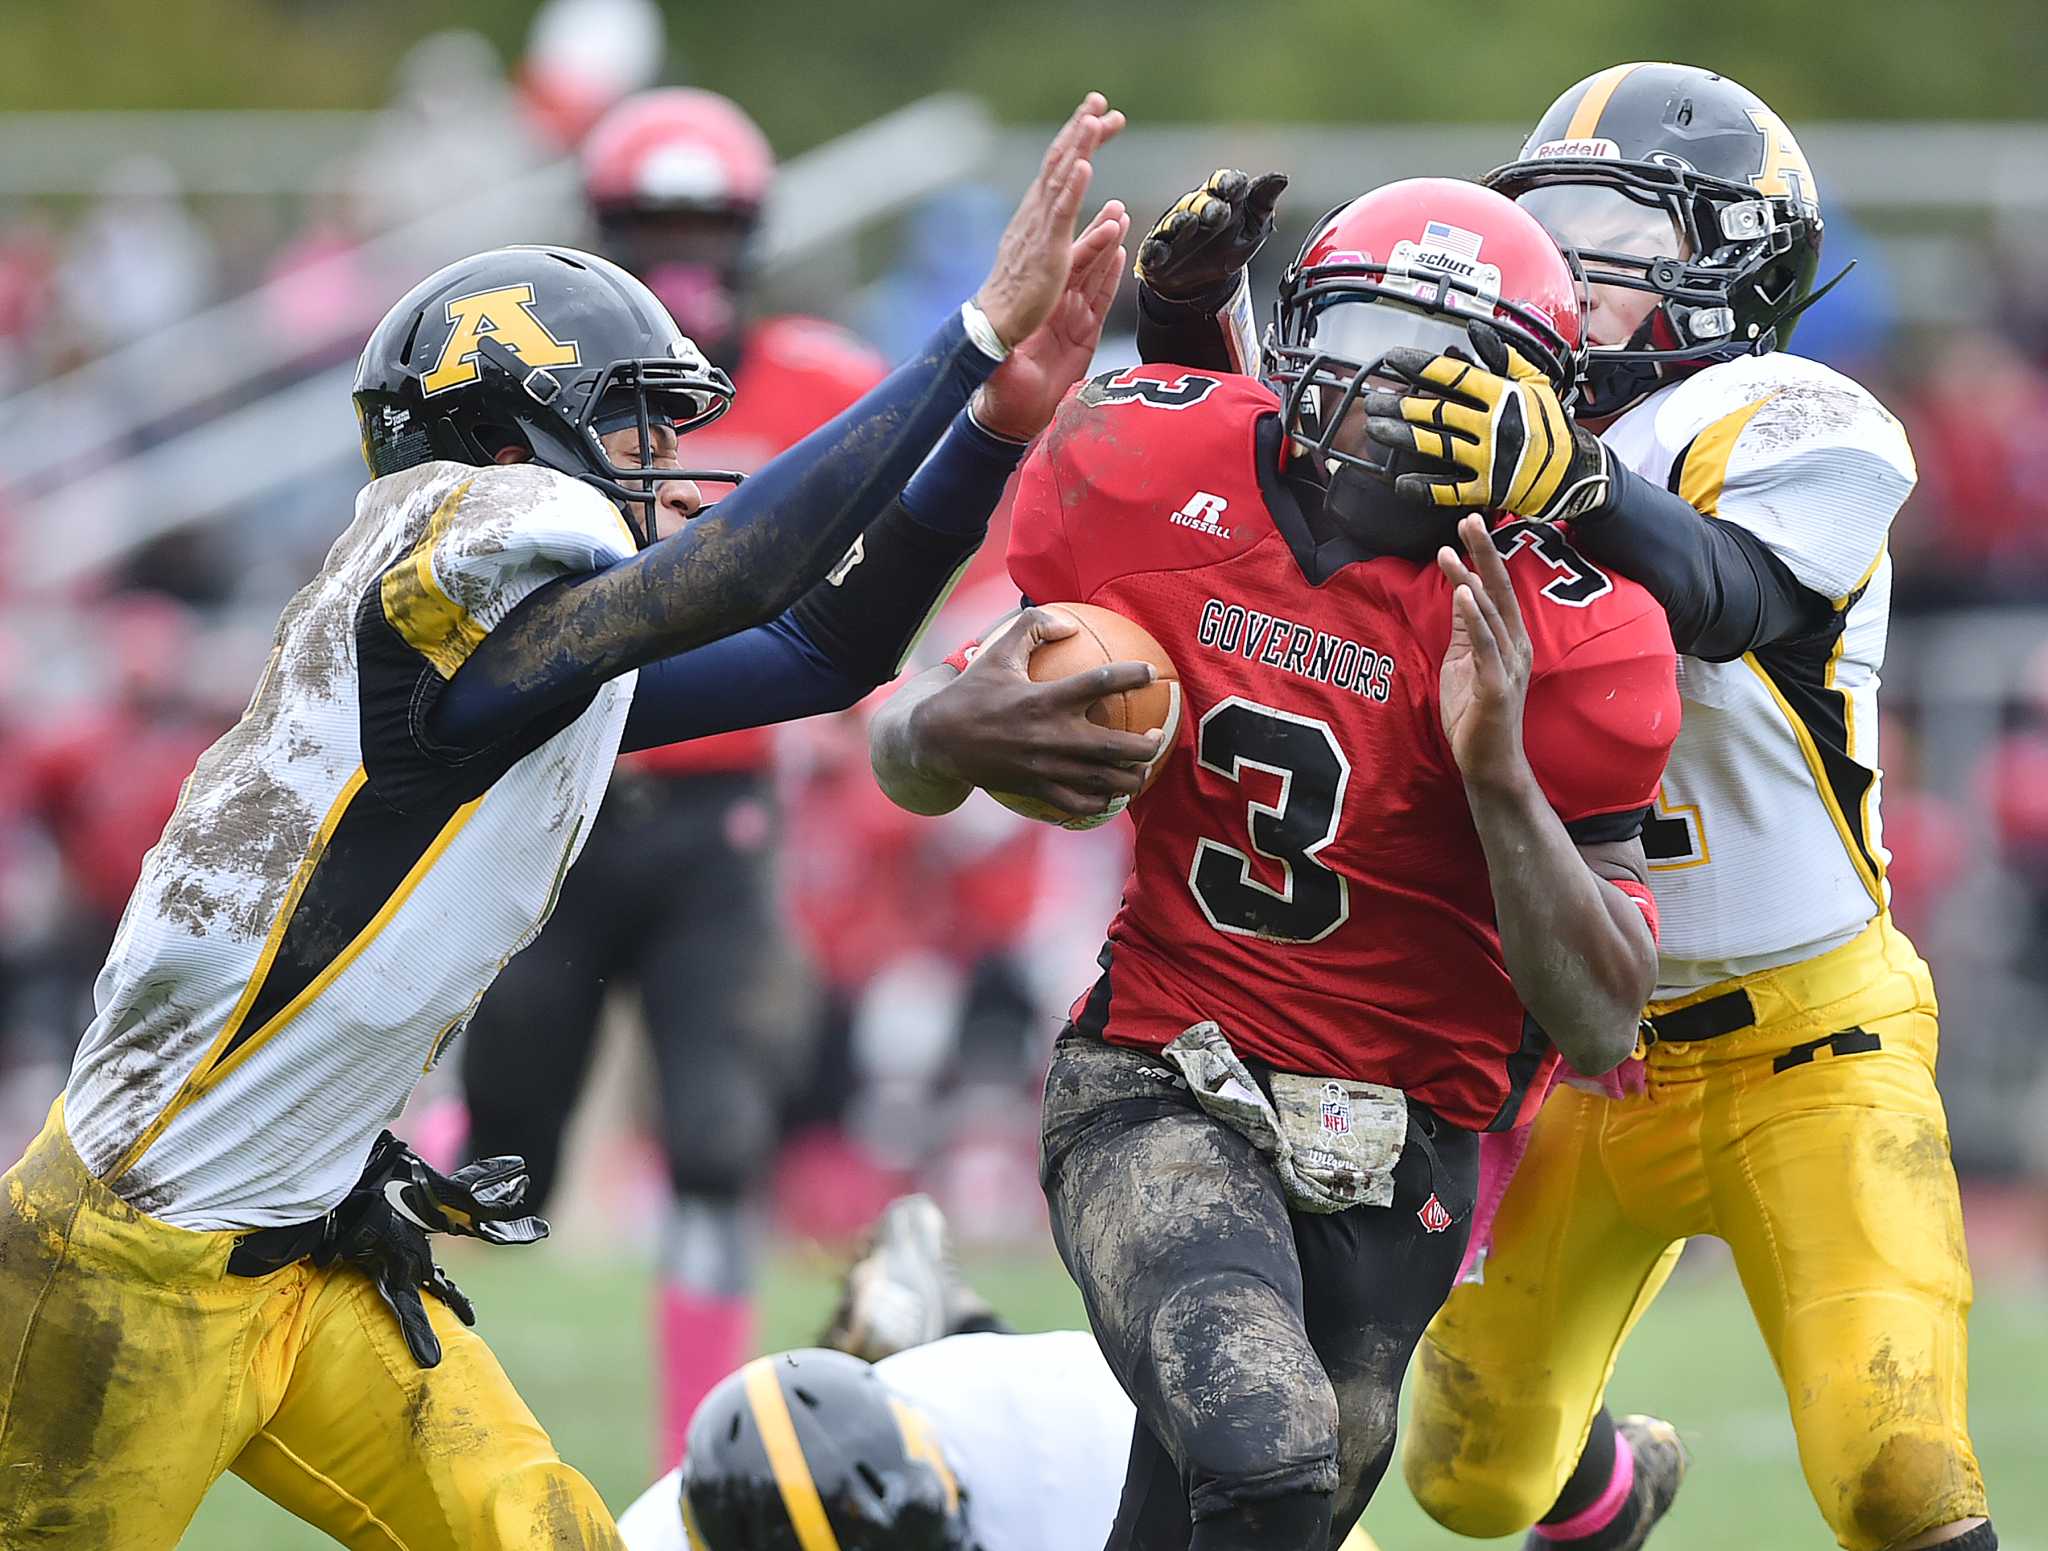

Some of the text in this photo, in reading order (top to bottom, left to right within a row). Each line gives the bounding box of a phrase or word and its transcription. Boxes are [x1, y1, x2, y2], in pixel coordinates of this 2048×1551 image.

[419, 283, 582, 399] A
[1076, 367, 1223, 410] 3
[1169, 511, 1231, 539] RUSSELL
[1181, 491, 1228, 525] R
[1491, 519, 1613, 608] 3
[1198, 598, 1395, 703] GOVERNORS
[1188, 694, 1352, 944] 3
[1323, 1113, 1350, 1133] NFL
